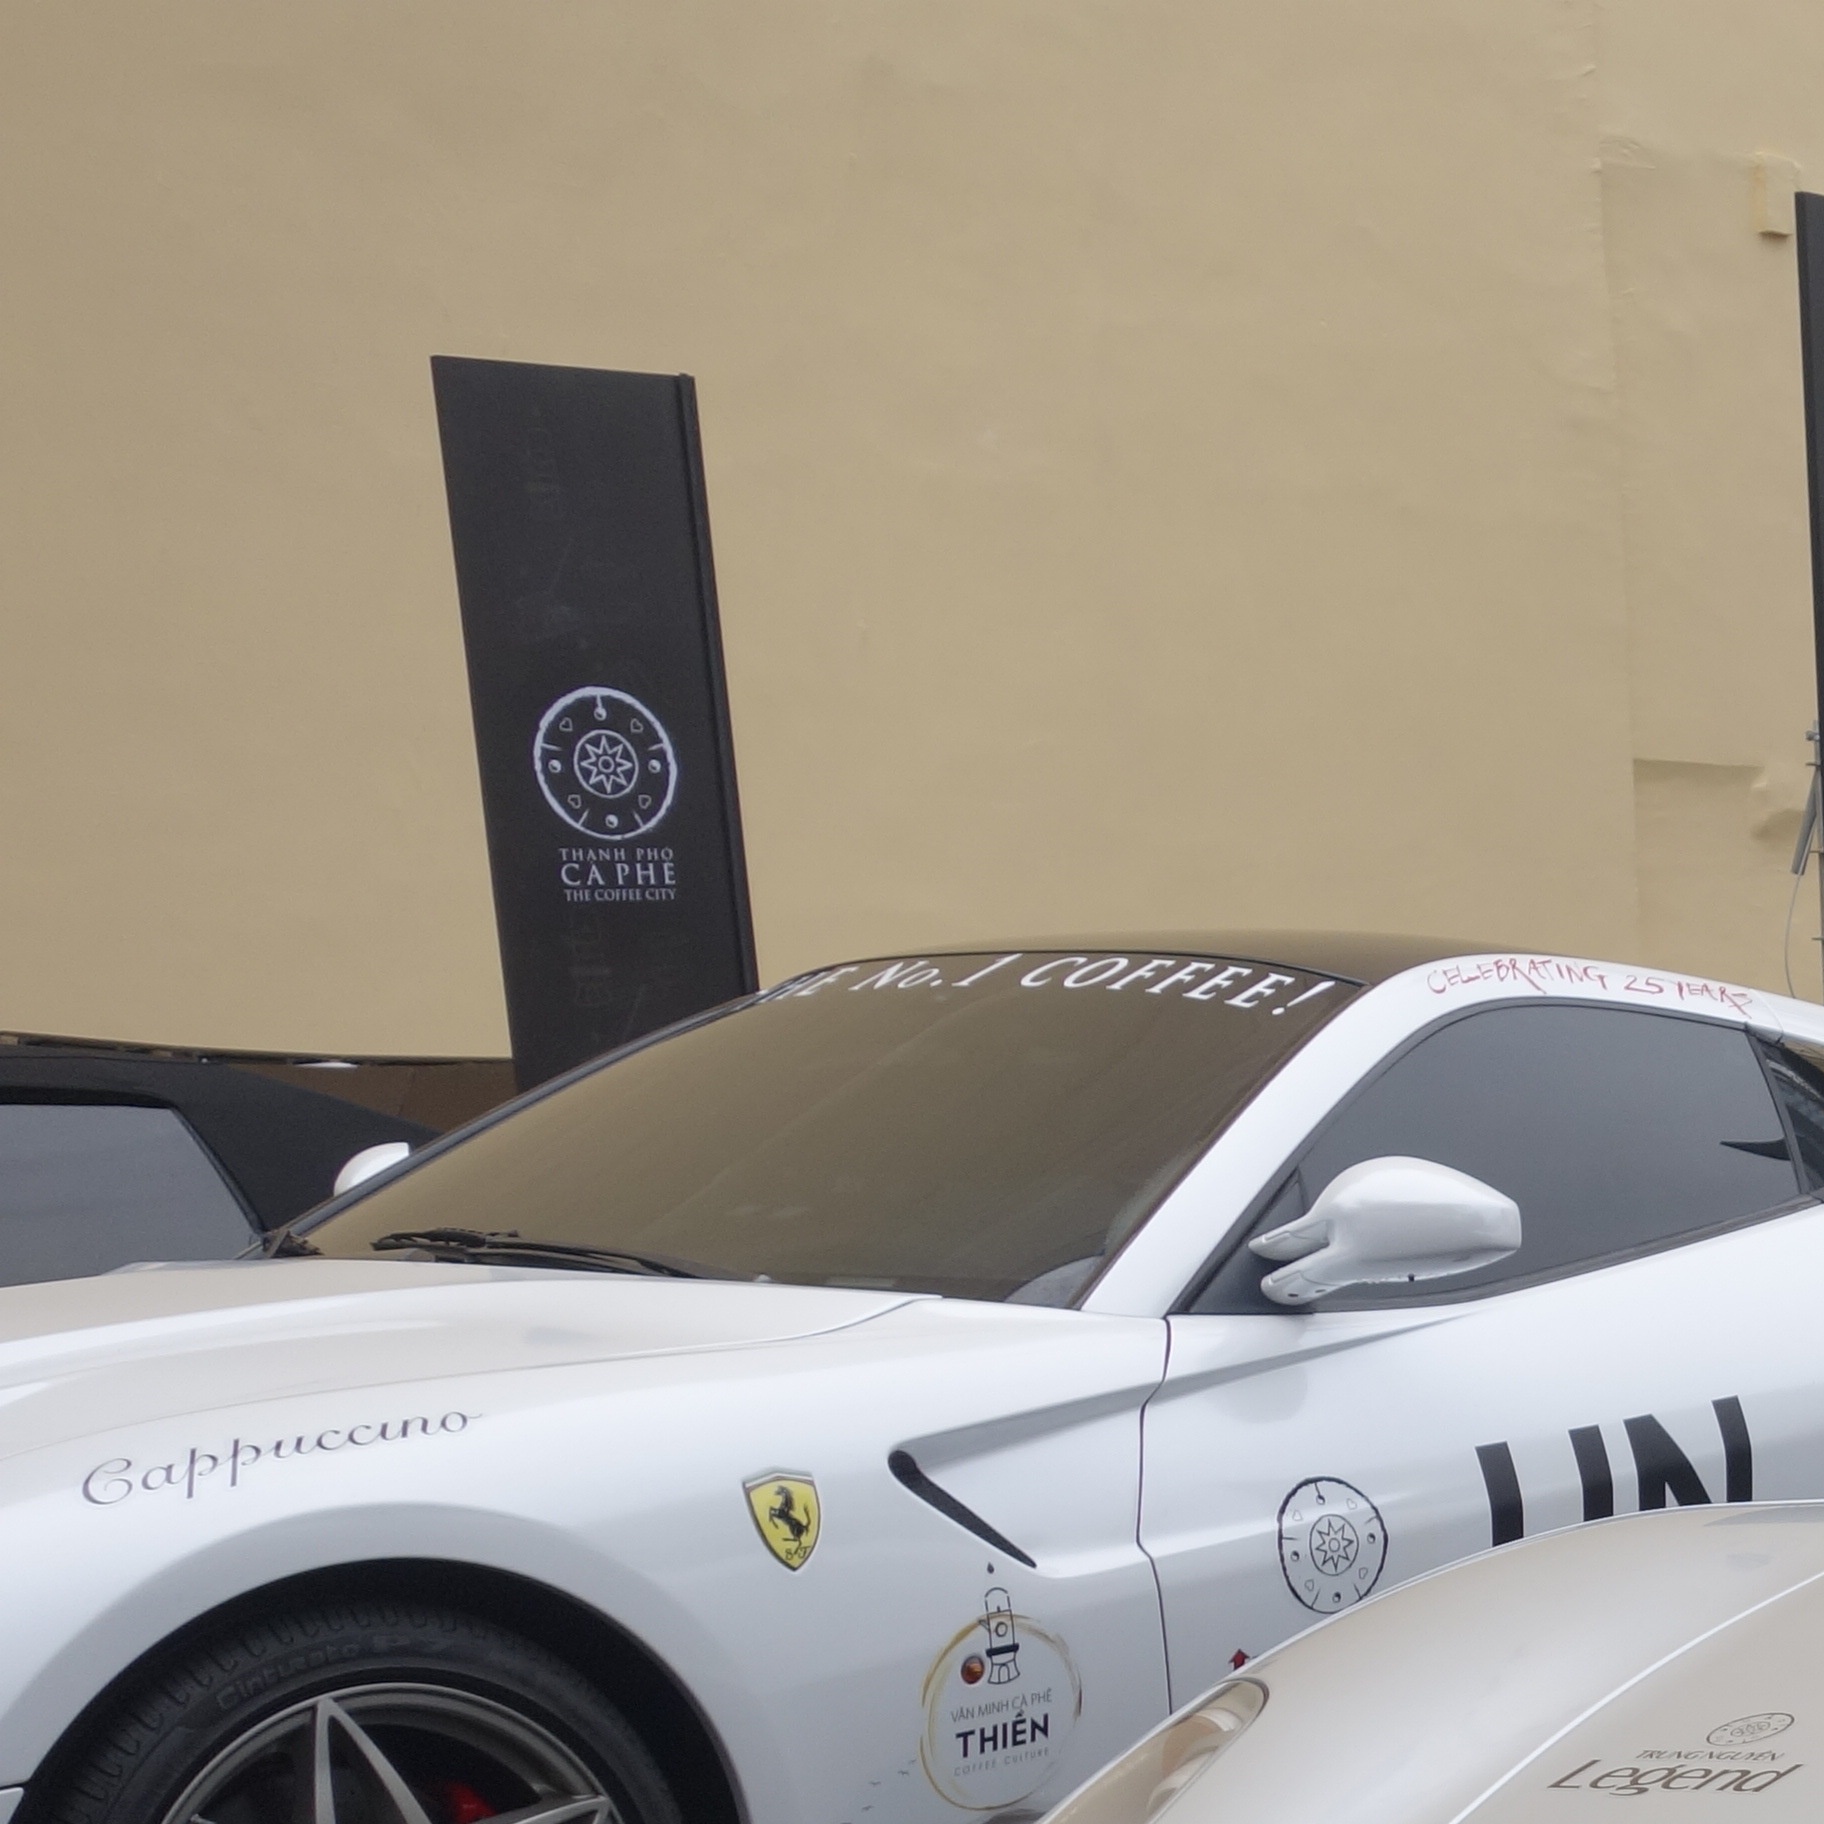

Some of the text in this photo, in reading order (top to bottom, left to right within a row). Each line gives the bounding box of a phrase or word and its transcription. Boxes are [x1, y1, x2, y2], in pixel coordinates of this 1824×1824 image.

[563, 887, 677, 902] THE COFFEE CITY
[1019, 956, 1335, 1016] COFFEE!
[1427, 958, 1609, 996] CELEBRATING
[1624, 974, 1665, 995] 25
[81, 1410, 484, 1506] Cappuccino
[1475, 1395, 1754, 1548] UN
[977, 1699, 1009, 1718] MINH
[1635, 1749, 1700, 1761] TRUNG
[1547, 1758, 1804, 1797] Legend
